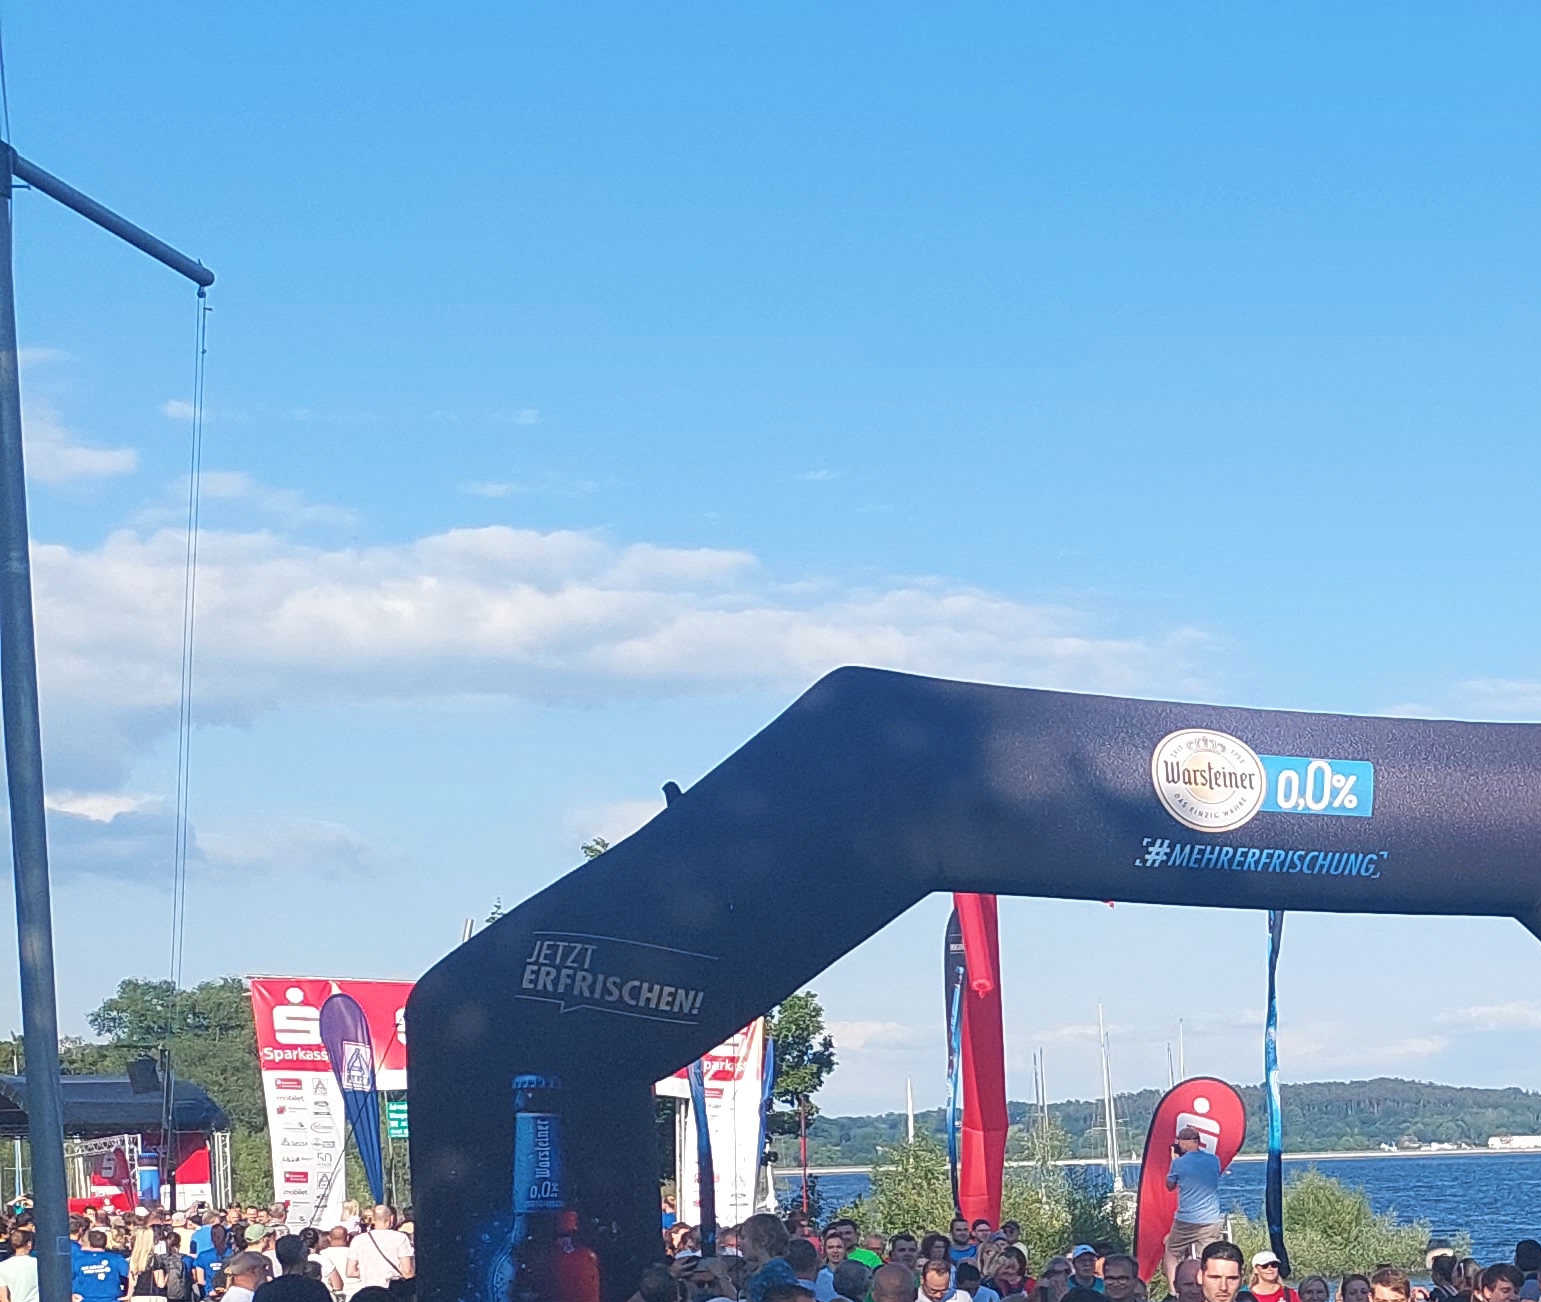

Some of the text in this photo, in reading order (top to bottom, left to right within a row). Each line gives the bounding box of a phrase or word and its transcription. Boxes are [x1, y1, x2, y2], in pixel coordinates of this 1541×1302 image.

[1163, 760, 1255, 790] Warsteiner
[1276, 760, 1358, 810] 0,0%
[1145, 838, 1378, 877] #MEHRERFRISCHUNG
[526, 940, 597, 969] JETZT
[522, 965, 704, 1014] ERFRISCHEN!
[534, 1119, 551, 1178] Warsteiner
